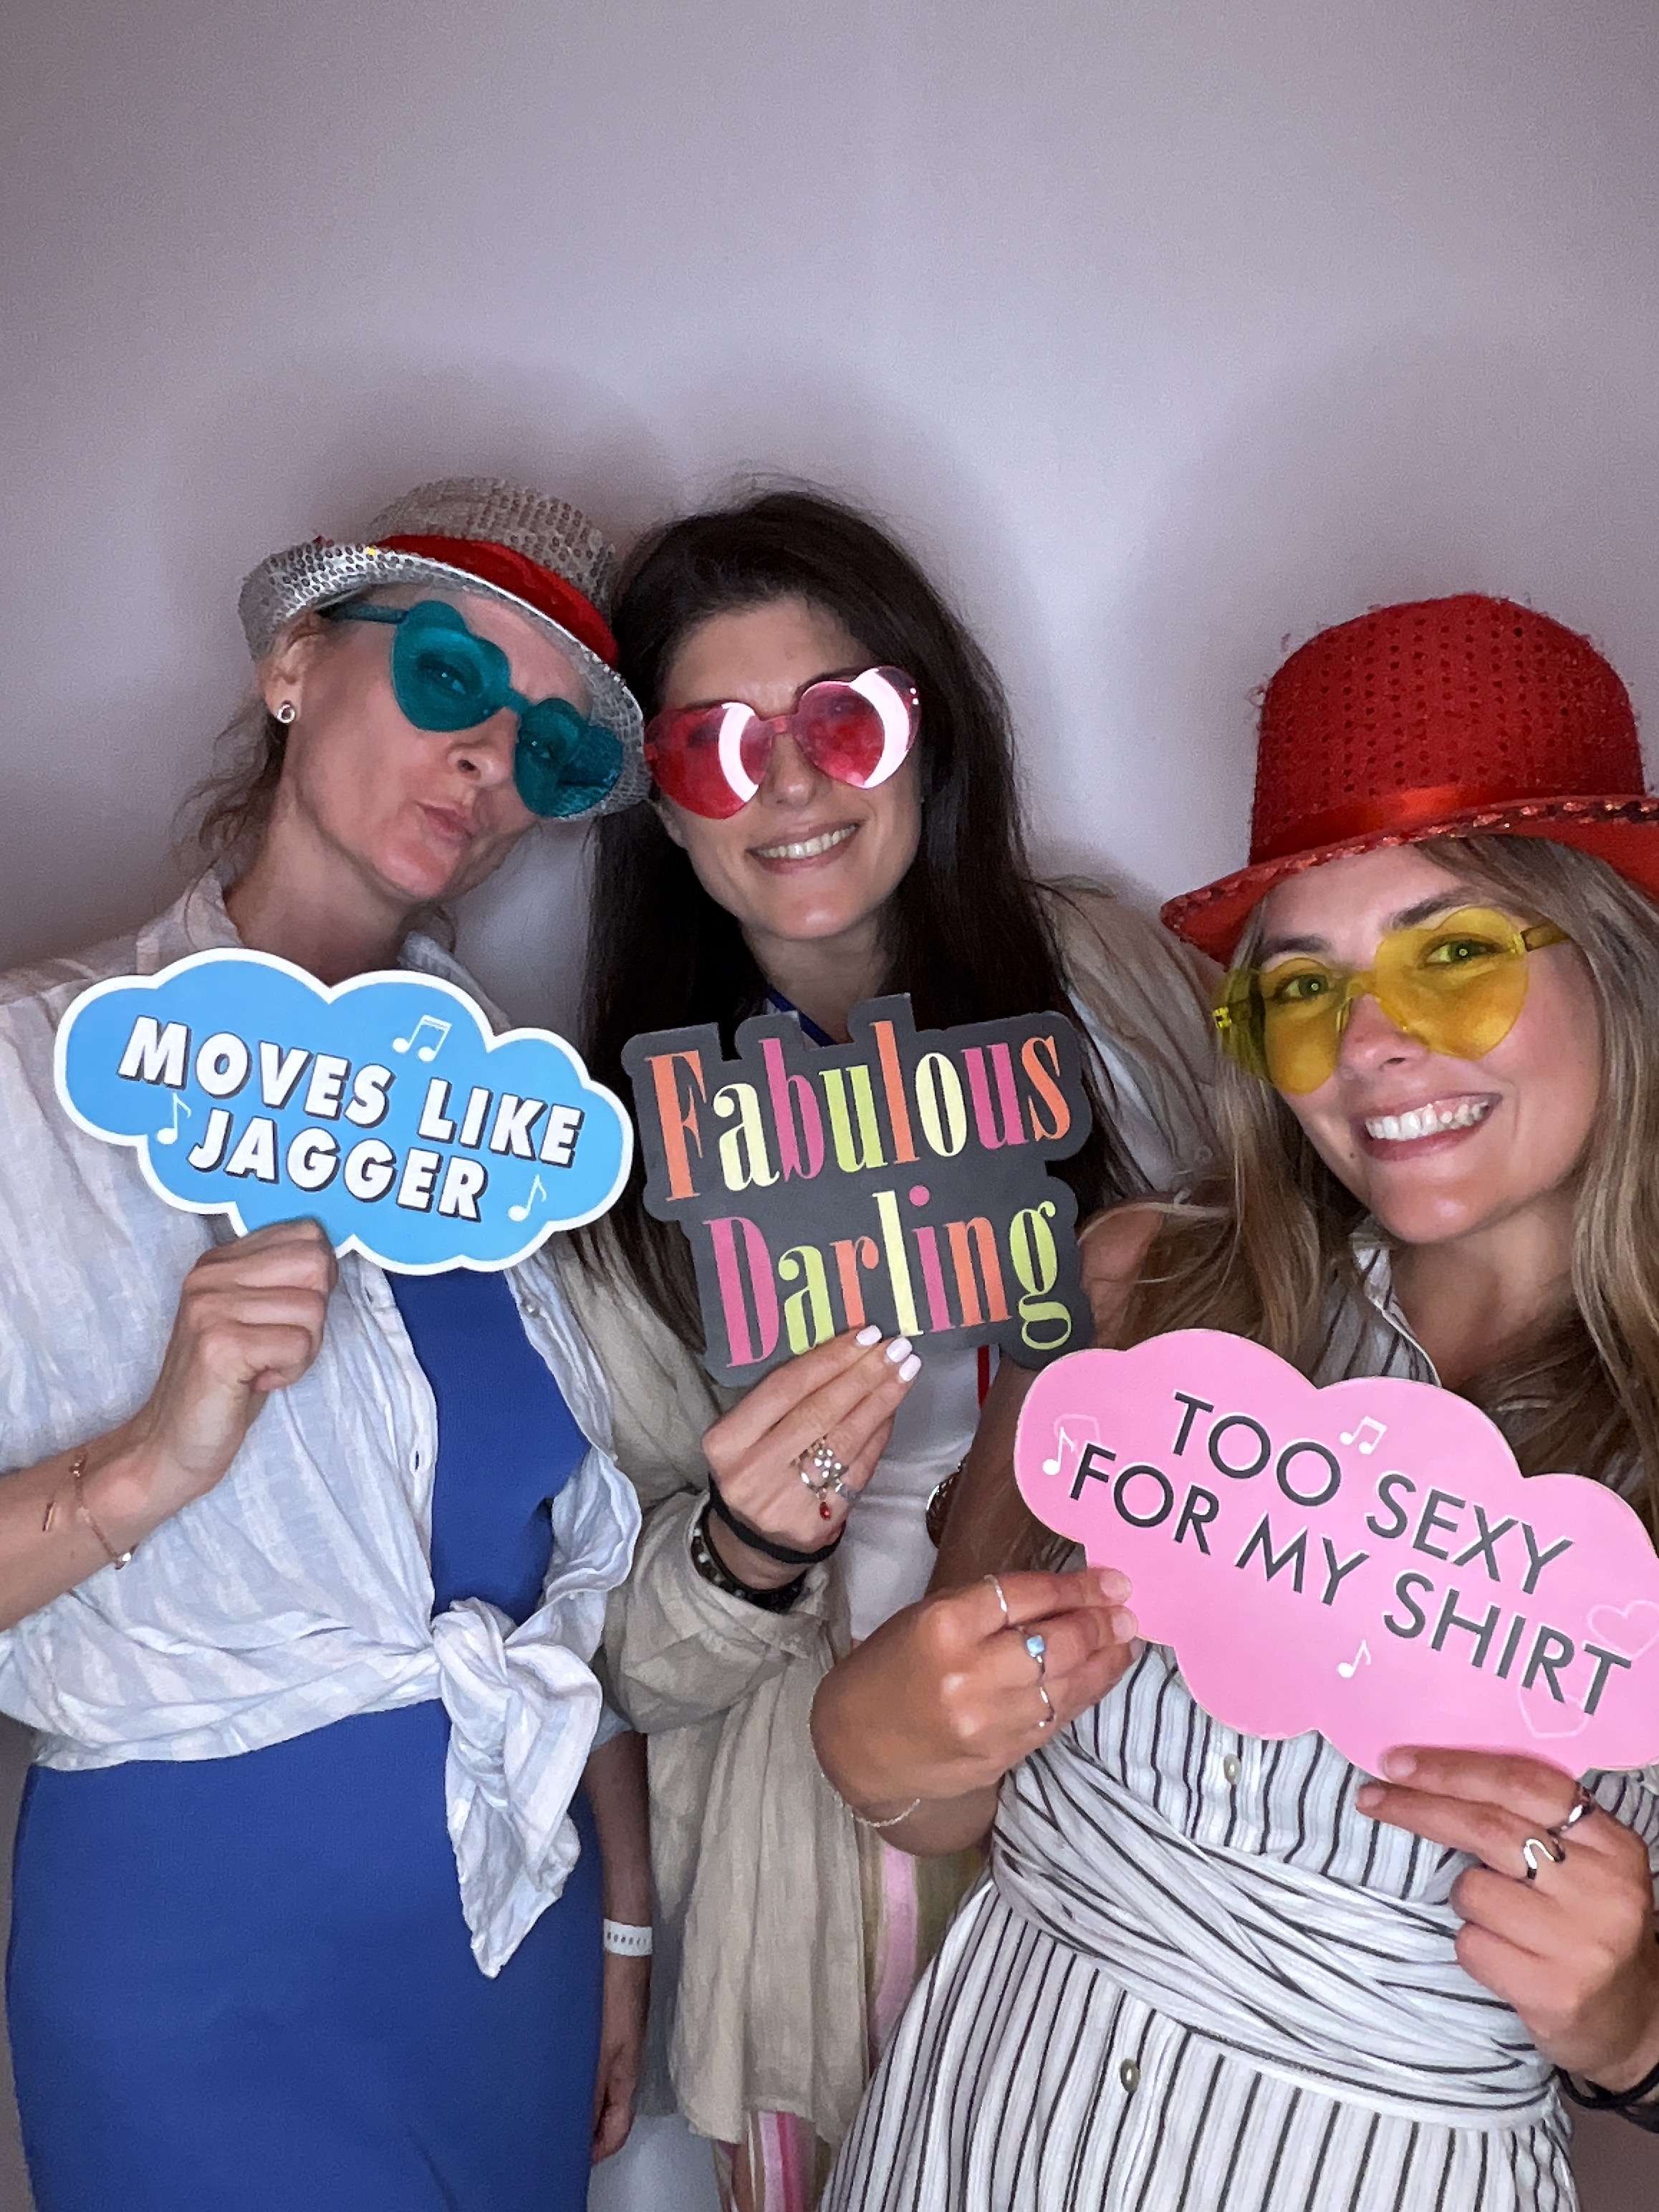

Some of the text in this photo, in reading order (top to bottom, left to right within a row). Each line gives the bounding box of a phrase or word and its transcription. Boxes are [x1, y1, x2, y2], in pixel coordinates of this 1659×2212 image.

[118, 1016, 585, 1168] MOVES LIKE
[187, 1109, 488, 1222] JAGGER
[645, 1021, 1072, 1201] Fabulous
[703, 1185, 1072, 1367] Darling
[1070, 1443, 1632, 1715] FOR MY SHIRT
[1171, 1391, 1573, 1595] TOO SEXY
